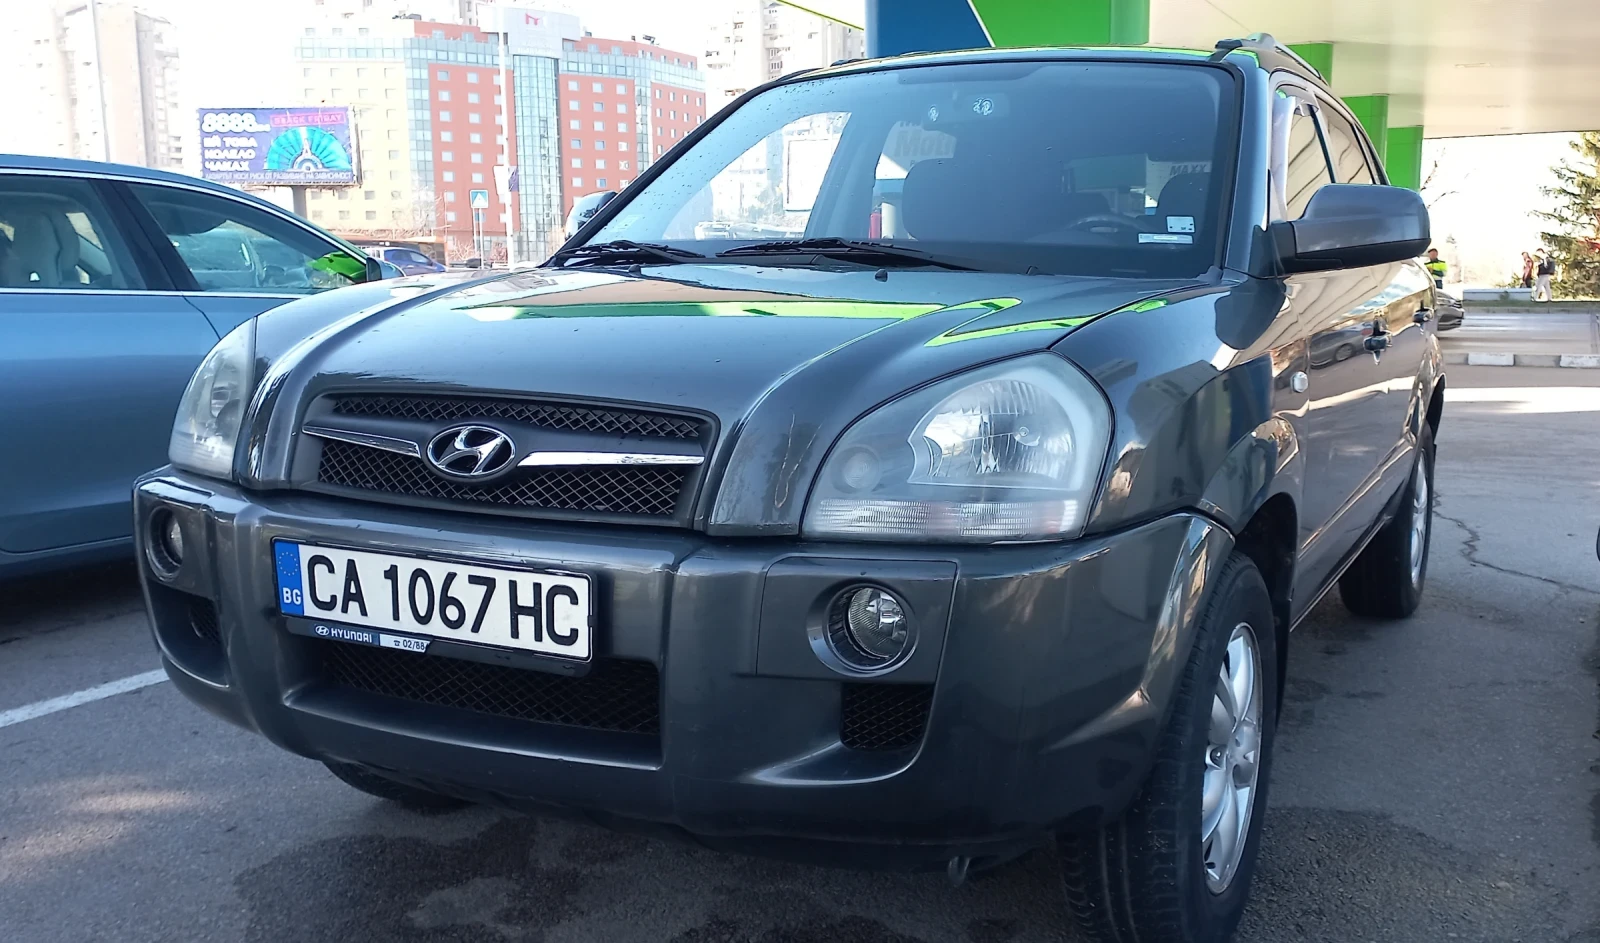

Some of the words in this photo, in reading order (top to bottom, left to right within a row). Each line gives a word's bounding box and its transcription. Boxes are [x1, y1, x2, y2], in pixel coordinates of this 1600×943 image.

[1170, 164, 1207, 175] MAXX
[282, 587, 302, 605] BG
[307, 554, 369, 618] CA
[383, 563, 497, 635] 1067
[508, 579, 579, 646] HC
[330, 627, 373, 643] HYUNDAI
